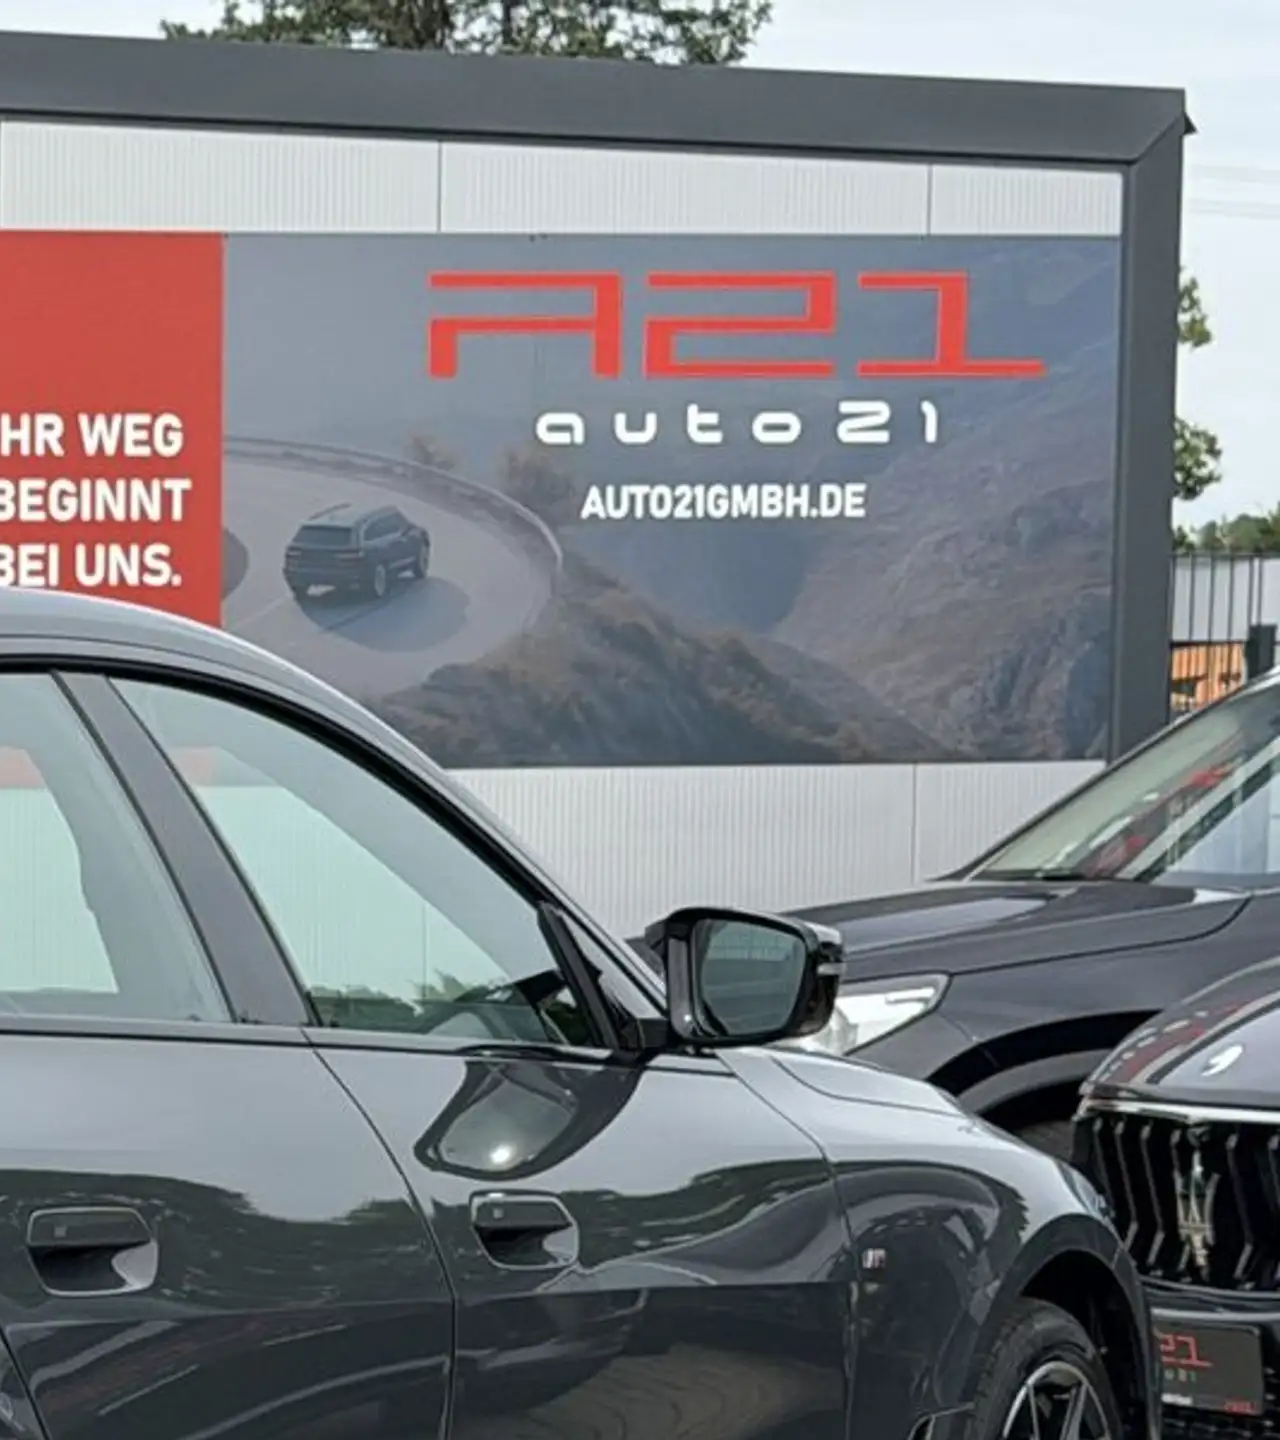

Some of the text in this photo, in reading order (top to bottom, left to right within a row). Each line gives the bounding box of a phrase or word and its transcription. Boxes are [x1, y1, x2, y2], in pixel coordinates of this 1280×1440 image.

[426, 271, 1044, 378] A21
[77, 412, 184, 458] WEG
[580, 483, 867, 519] AUTO21GMBH.DE
[74, 543, 182, 588] UNS.
[1160, 1333, 1214, 1367] 21
